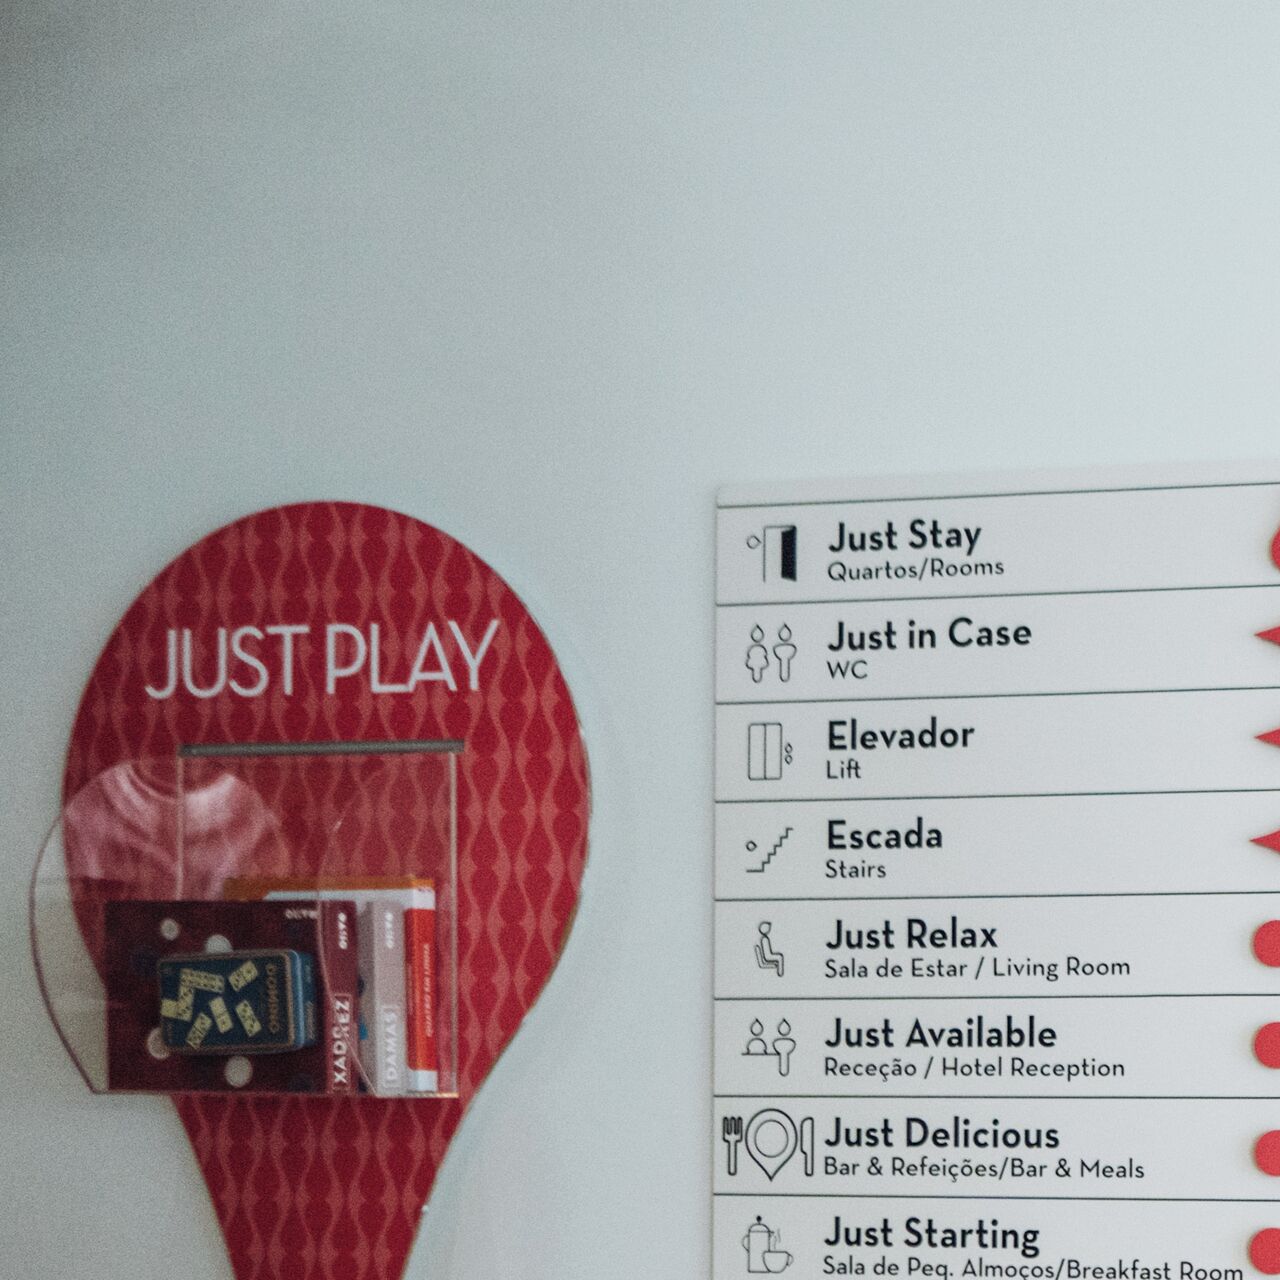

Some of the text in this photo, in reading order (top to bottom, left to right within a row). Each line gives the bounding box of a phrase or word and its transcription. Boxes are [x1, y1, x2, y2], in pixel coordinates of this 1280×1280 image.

[827, 518, 983, 557] Just Stay
[827, 557, 1005, 583] Quartos/Rooms
[827, 616, 1033, 653] Just in Case
[146, 618, 501, 700] JUST PLAY
[826, 659, 868, 680] WC
[827, 715, 976, 751] Elevador
[826, 757, 862, 780] Lift
[827, 815, 943, 851] Escada
[825, 858, 887, 879] Stairs
[825, 915, 999, 951] Just Relax
[824, 955, 1131, 983] Sala de Estar / Living Room
[386, 1012, 398, 1082] DAMAS
[824, 1014, 1058, 1049] Just Available
[824, 1055, 1125, 1083] Receção / Hotel Reception
[823, 1115, 1060, 1150] Just Delicious
[823, 1155, 1145, 1184] Bar & Refeições/Bar & Meals
[823, 1215, 1041, 1260] Just Starting
[822, 1254, 866, 1276] Sala
[872, 1255, 900, 1277] de
